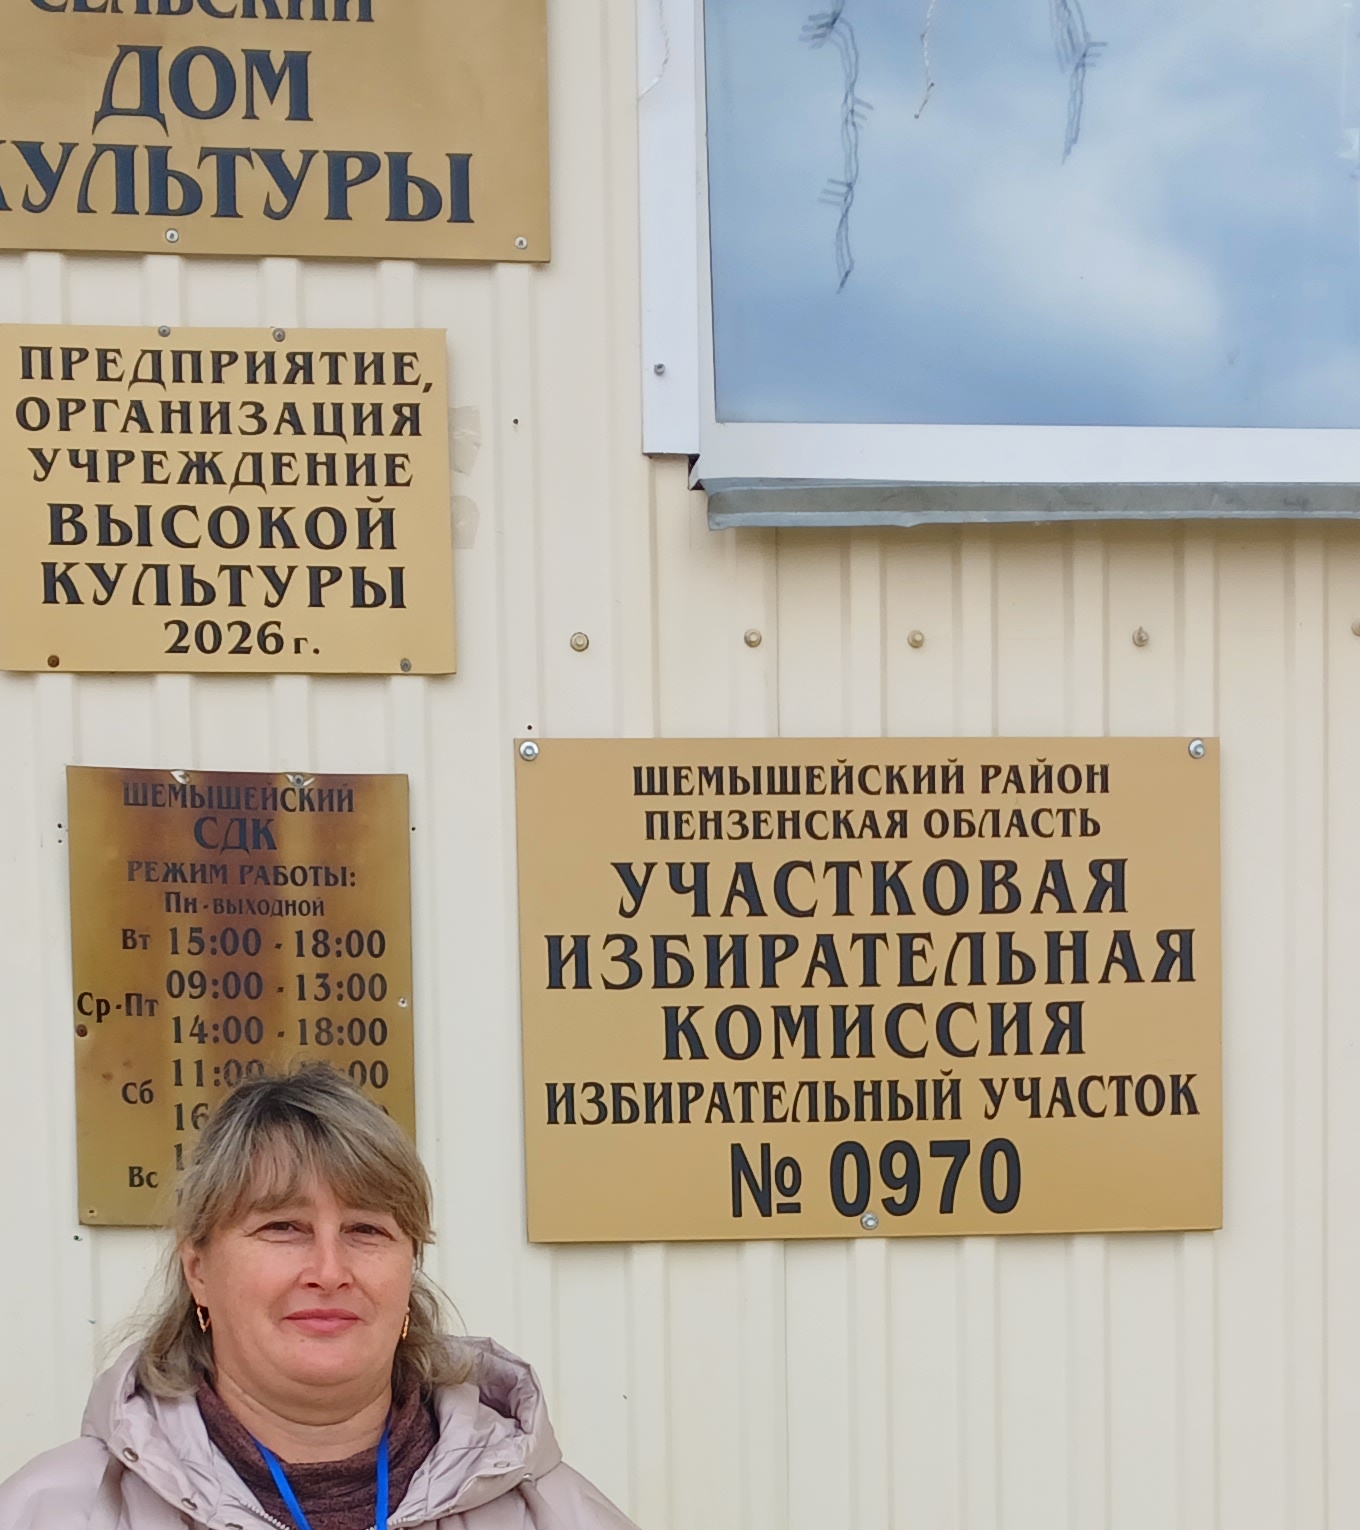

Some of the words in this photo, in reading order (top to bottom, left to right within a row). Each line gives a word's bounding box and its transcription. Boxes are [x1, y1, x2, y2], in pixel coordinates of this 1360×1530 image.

[91, 44, 314, 137] ДОМ
[19, 345, 433, 394] ПРЕДПРИЯТИЕ,
[15, 396, 422, 444] ОРГАНИЗАЦИЯ
[27, 447, 413, 494] УЧРЕЖДЕНИЕ
[47, 495, 398, 551] ВЫСОКОЙ
[40, 561, 407, 609] КУЛЬТУРЫ
[123, 781, 354, 813] ШЕМЫШЕЙСКИЙ
[632, 757, 965, 796] ШЕМЫШЕЙСКИЙ
[980, 757, 1110, 795] РАЙОН
[193, 815, 278, 855] СДК
[644, 809, 908, 841] ПЕНЗЕНСКАЯ
[923, 807, 1101, 839] ОБЛАСТЬ
[127, 860, 228, 885] РЕЖИМ
[241, 865, 356, 887] РАБОТЫ:
[610, 858, 1129, 919] УЧАСТКОВАЯ
[121, 928, 151, 950] Вт
[169, 926, 262, 957] 15:00
[294, 928, 386, 959] 18:00
[543, 928, 1197, 991] ИЗБИРАТЕЛЬНАЯ
[165, 969, 263, 1000] 09:00
[295, 972, 388, 1002] 13:00
[172, 1014, 264, 1045] 14:00
[297, 1016, 388, 1047] 18:00
[660, 1000, 1086, 1061] КОМИССИЯ
[121, 1078, 154, 1105] Сб
[544, 1068, 962, 1126] ИЗБИРАТЕЛЬНЫЙ
[978, 1073, 1201, 1121] УЧАСТОК
[128, 1165, 159, 1189] Вс
[730, 1142, 802, 1218] №
[829, 1137, 1022, 1218] 0970
